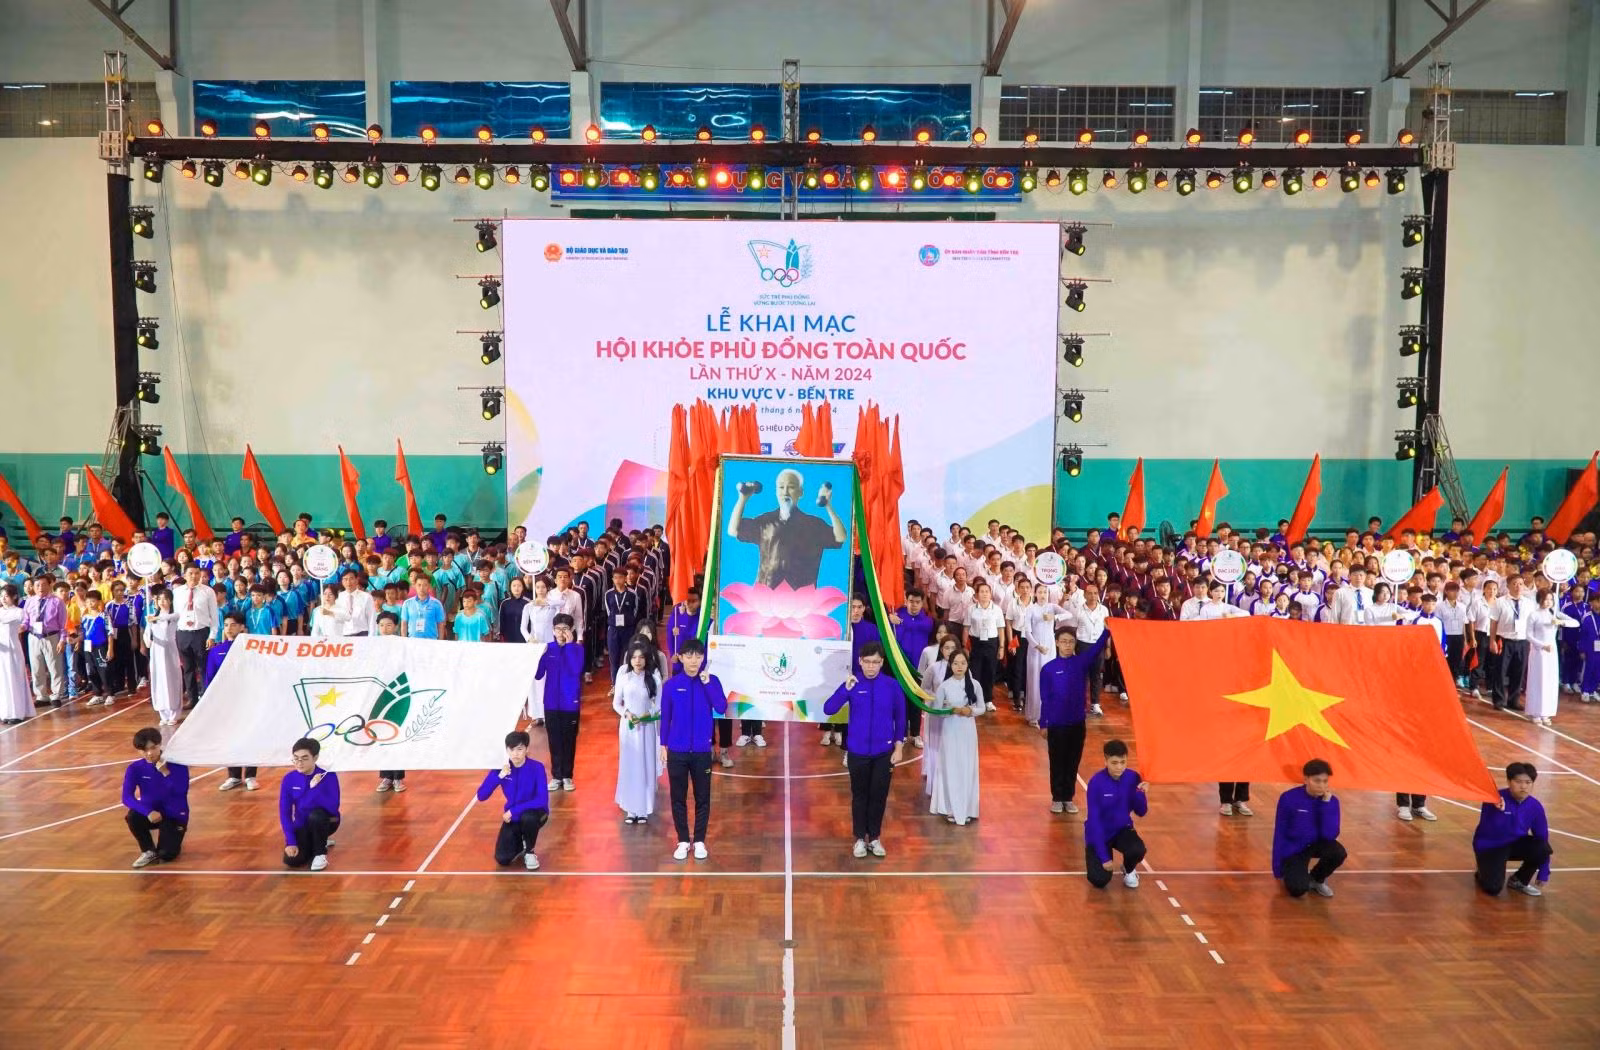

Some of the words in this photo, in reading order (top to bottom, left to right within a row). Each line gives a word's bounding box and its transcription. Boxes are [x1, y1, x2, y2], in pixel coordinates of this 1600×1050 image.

[707, 306, 731, 332] LỄ
[740, 314, 795, 332] KHAI
[804, 314, 856, 336] MẠC
[596, 336, 636, 362] HỘI
[643, 336, 705, 359] KHỎE
[710, 337, 756, 359] PHÙ
[761, 335, 828, 360] ĐỔNG
[833, 337, 895, 360] TOÀN
[900, 337, 967, 362] QUỐC
[690, 363, 721, 380] LẦN
[726, 364, 763, 381] THỨ
[765, 367, 777, 380] X
[791, 364, 830, 381] NĂM
[834, 367, 873, 381] 2024
[707, 387, 738, 400] KHU
[741, 387, 773, 402] VỰC
[775, 388, 786, 400] V
[797, 385, 825, 400] BẾN
[828, 388, 855, 400] TRE
[245, 638, 289, 656] PHÙ
[296, 635, 354, 657] ĐỔNG
